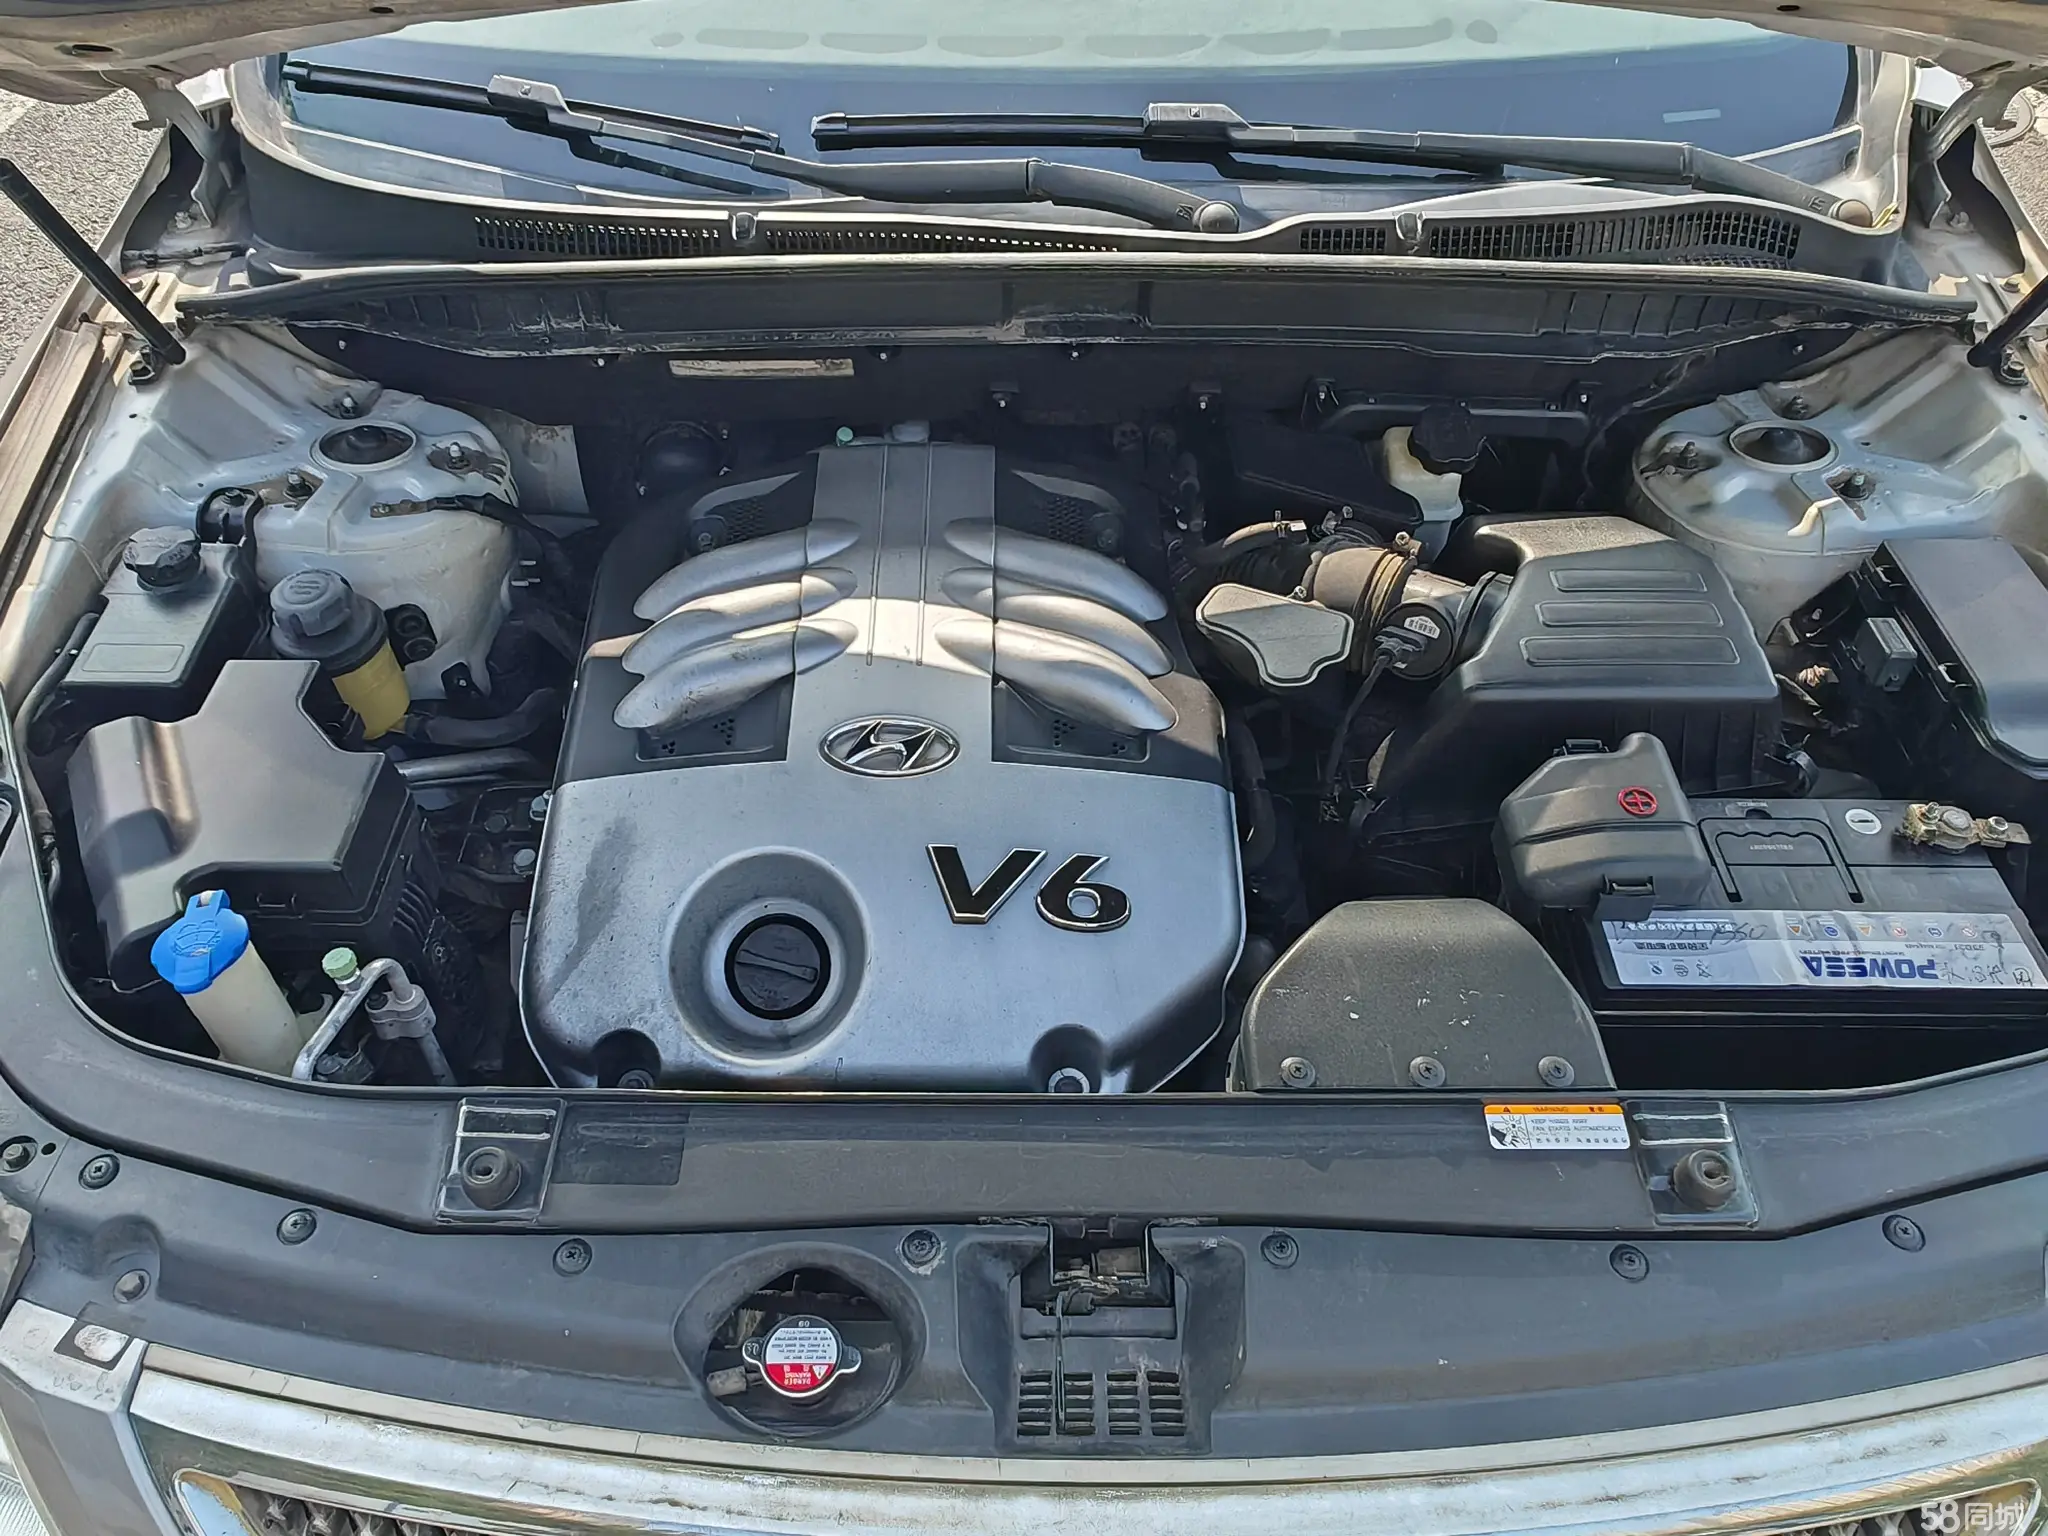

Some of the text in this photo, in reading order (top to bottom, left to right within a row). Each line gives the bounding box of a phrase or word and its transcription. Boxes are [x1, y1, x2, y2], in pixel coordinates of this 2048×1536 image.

[926, 843, 1132, 931] V6
[1799, 956, 1939, 980] POWSEA
[783, 1377, 811, 1385] DANGER
